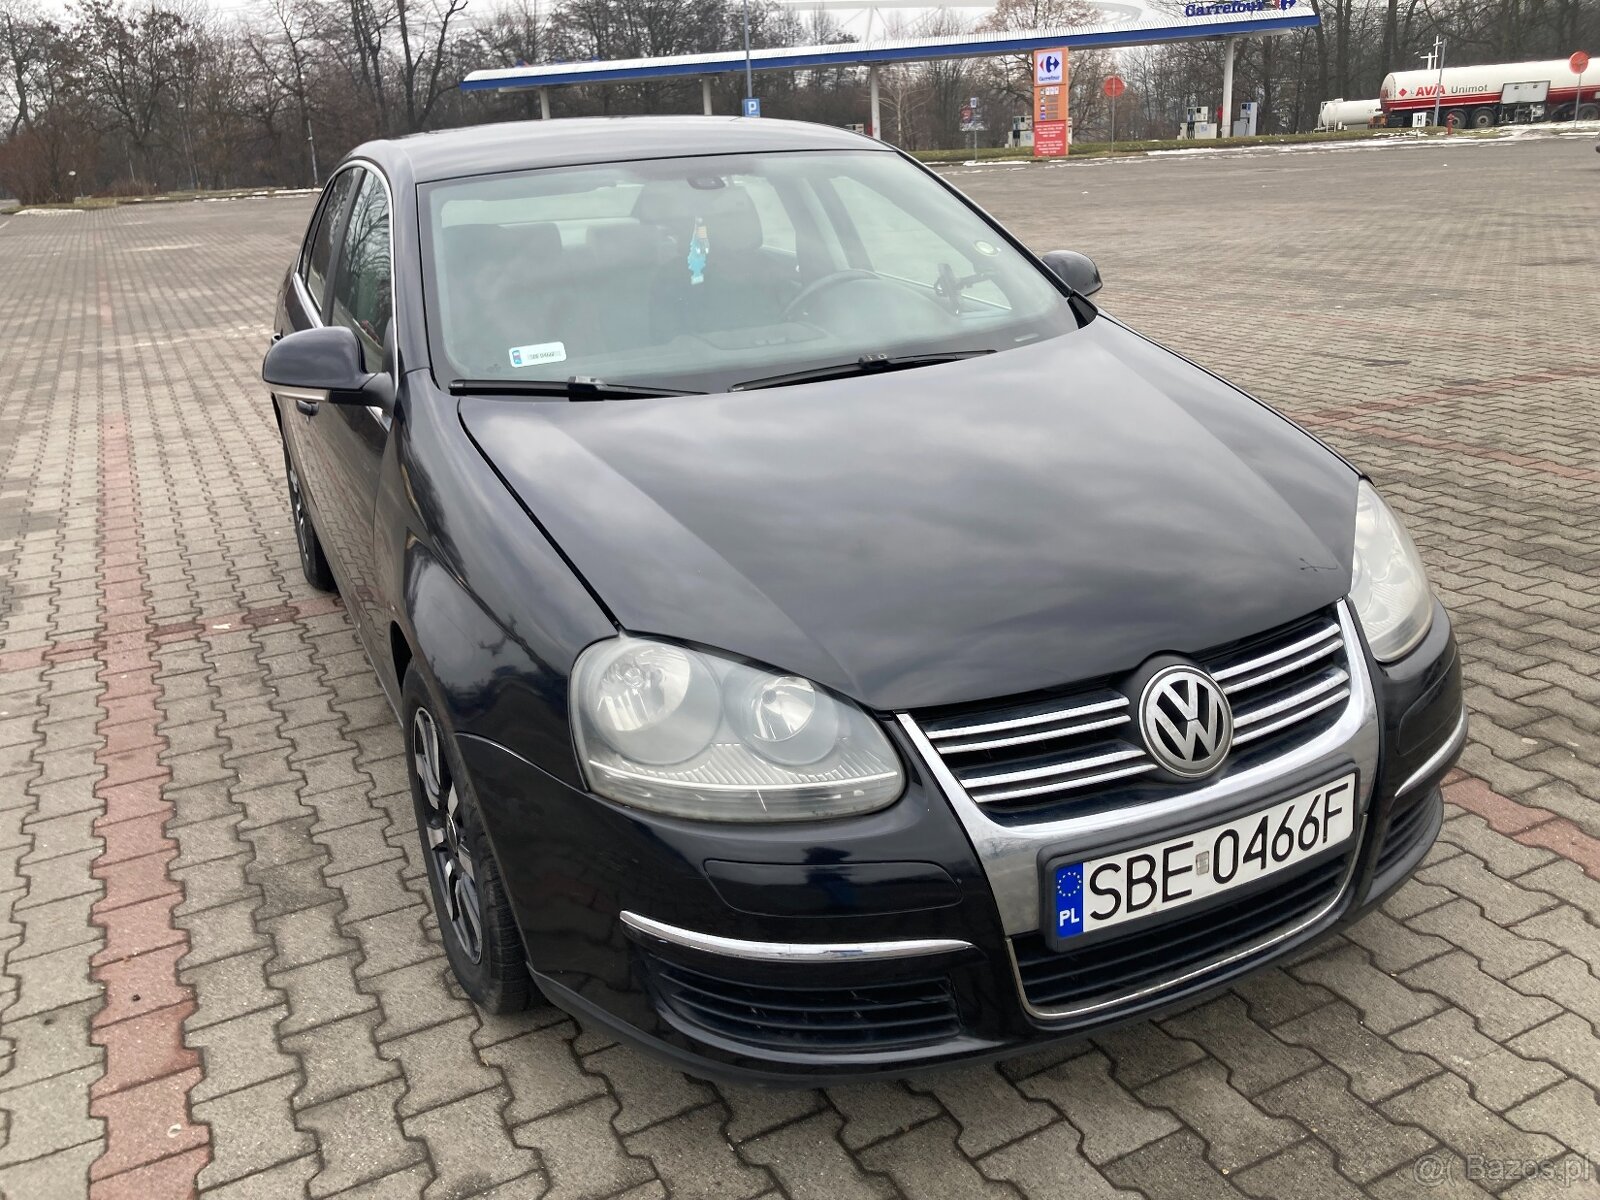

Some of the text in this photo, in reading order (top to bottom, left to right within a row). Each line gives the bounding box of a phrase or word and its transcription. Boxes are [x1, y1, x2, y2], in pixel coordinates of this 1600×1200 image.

[1451, 84, 1488, 94] Unimot
[748, 101, 757, 114] P
[1089, 782, 1349, 920] SBE 0466F
[1059, 907, 1080, 927] PL
